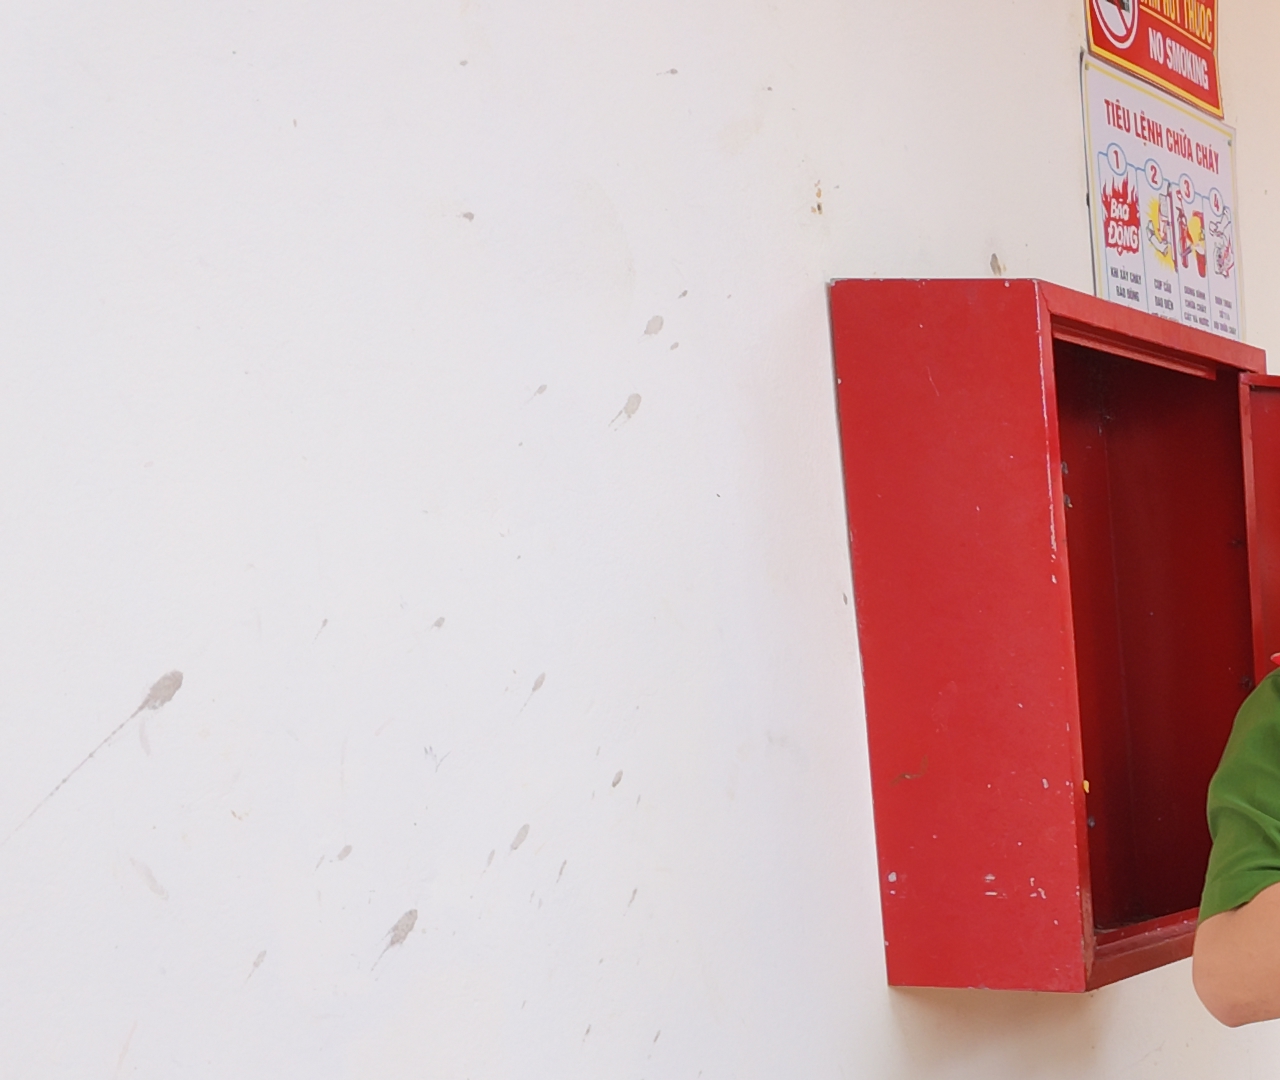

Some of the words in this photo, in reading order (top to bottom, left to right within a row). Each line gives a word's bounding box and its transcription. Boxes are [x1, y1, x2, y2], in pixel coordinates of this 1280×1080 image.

[1148, 27, 1164, 65] NO
[1166, 37, 1209, 90] SMOKING
[1104, 99, 1131, 133] TIÊU
[1134, 110, 1164, 147] LỆNH
[1166, 128, 1193, 162] CHỮA
[1195, 143, 1219, 175] CHÁY
[1113, 150, 1120, 169] 1
[1150, 165, 1158, 185] 2
[1184, 179, 1191, 199] 3
[1213, 193, 1220, 212] 4
